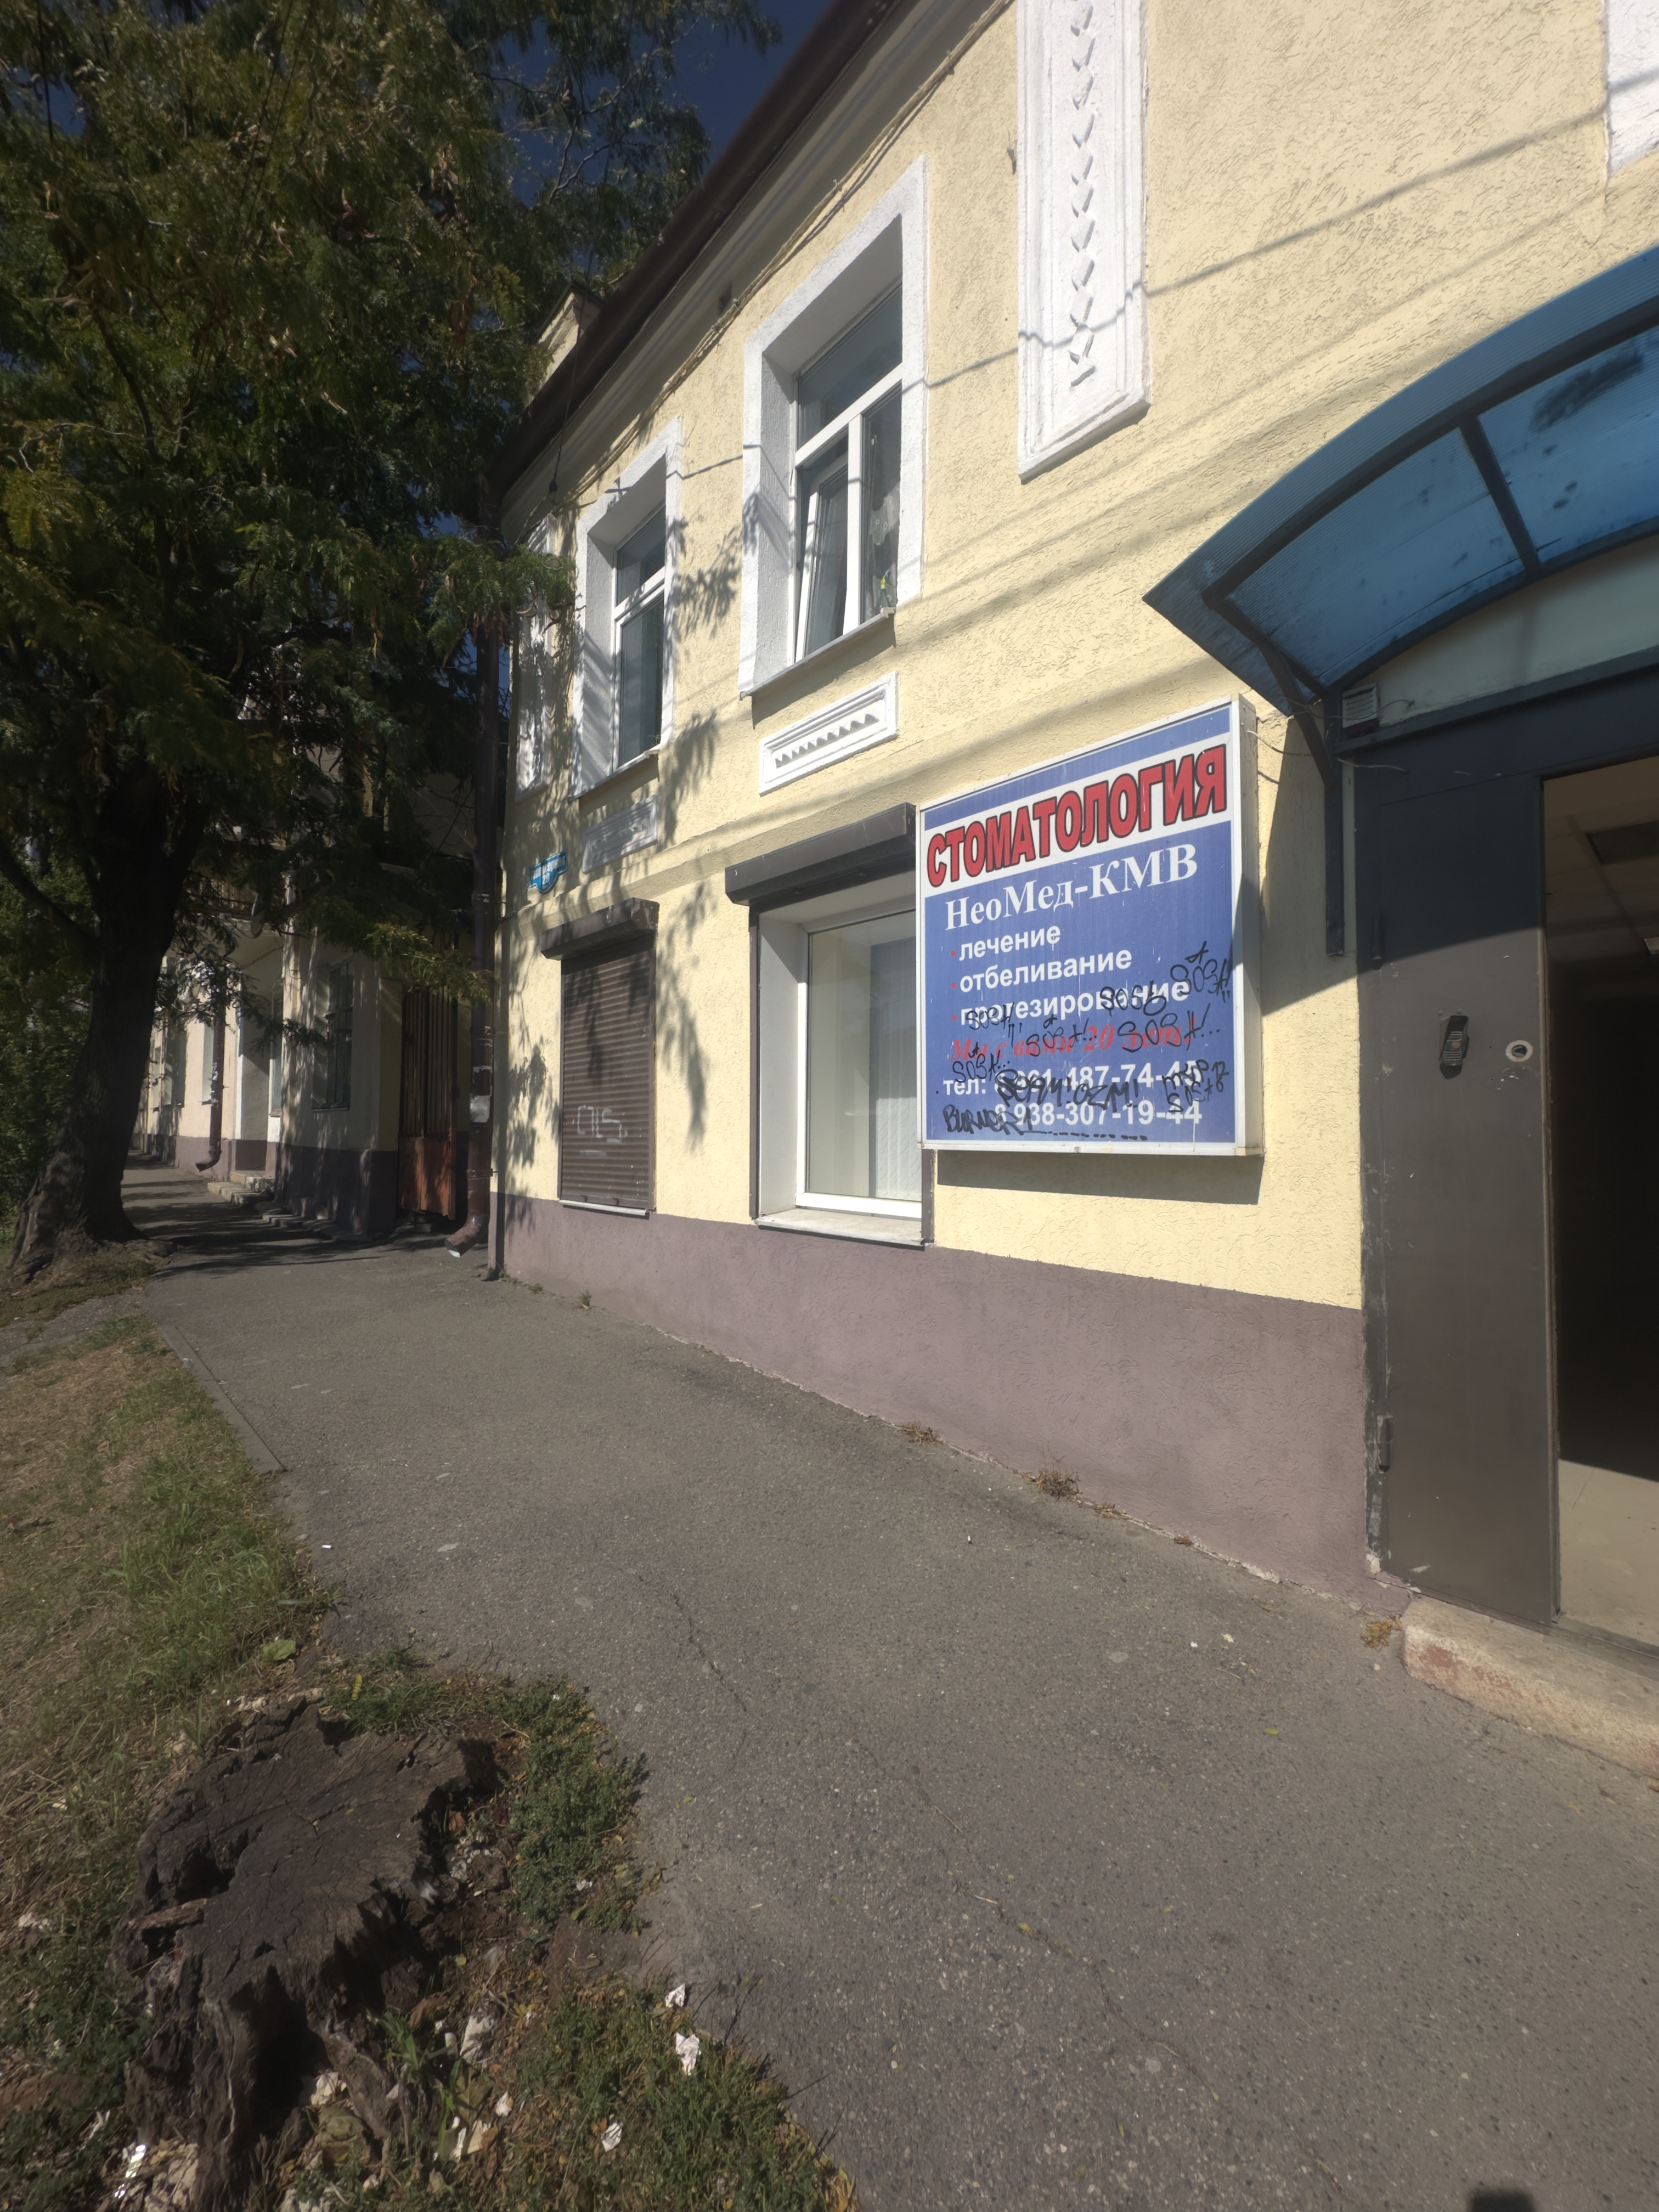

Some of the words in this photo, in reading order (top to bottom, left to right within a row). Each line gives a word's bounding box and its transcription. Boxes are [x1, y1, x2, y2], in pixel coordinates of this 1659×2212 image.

[927, 744, 1227, 888] СТОМАТОЛОГИЯ
[945, 844, 1198, 930] НеоМед-КМВ
[959, 926, 1061, 961] лечение
[960, 949, 1132, 993] отбеливание
[1084, 1024, 1114, 1051] 20
[943, 1079, 986, 1096] тел:
